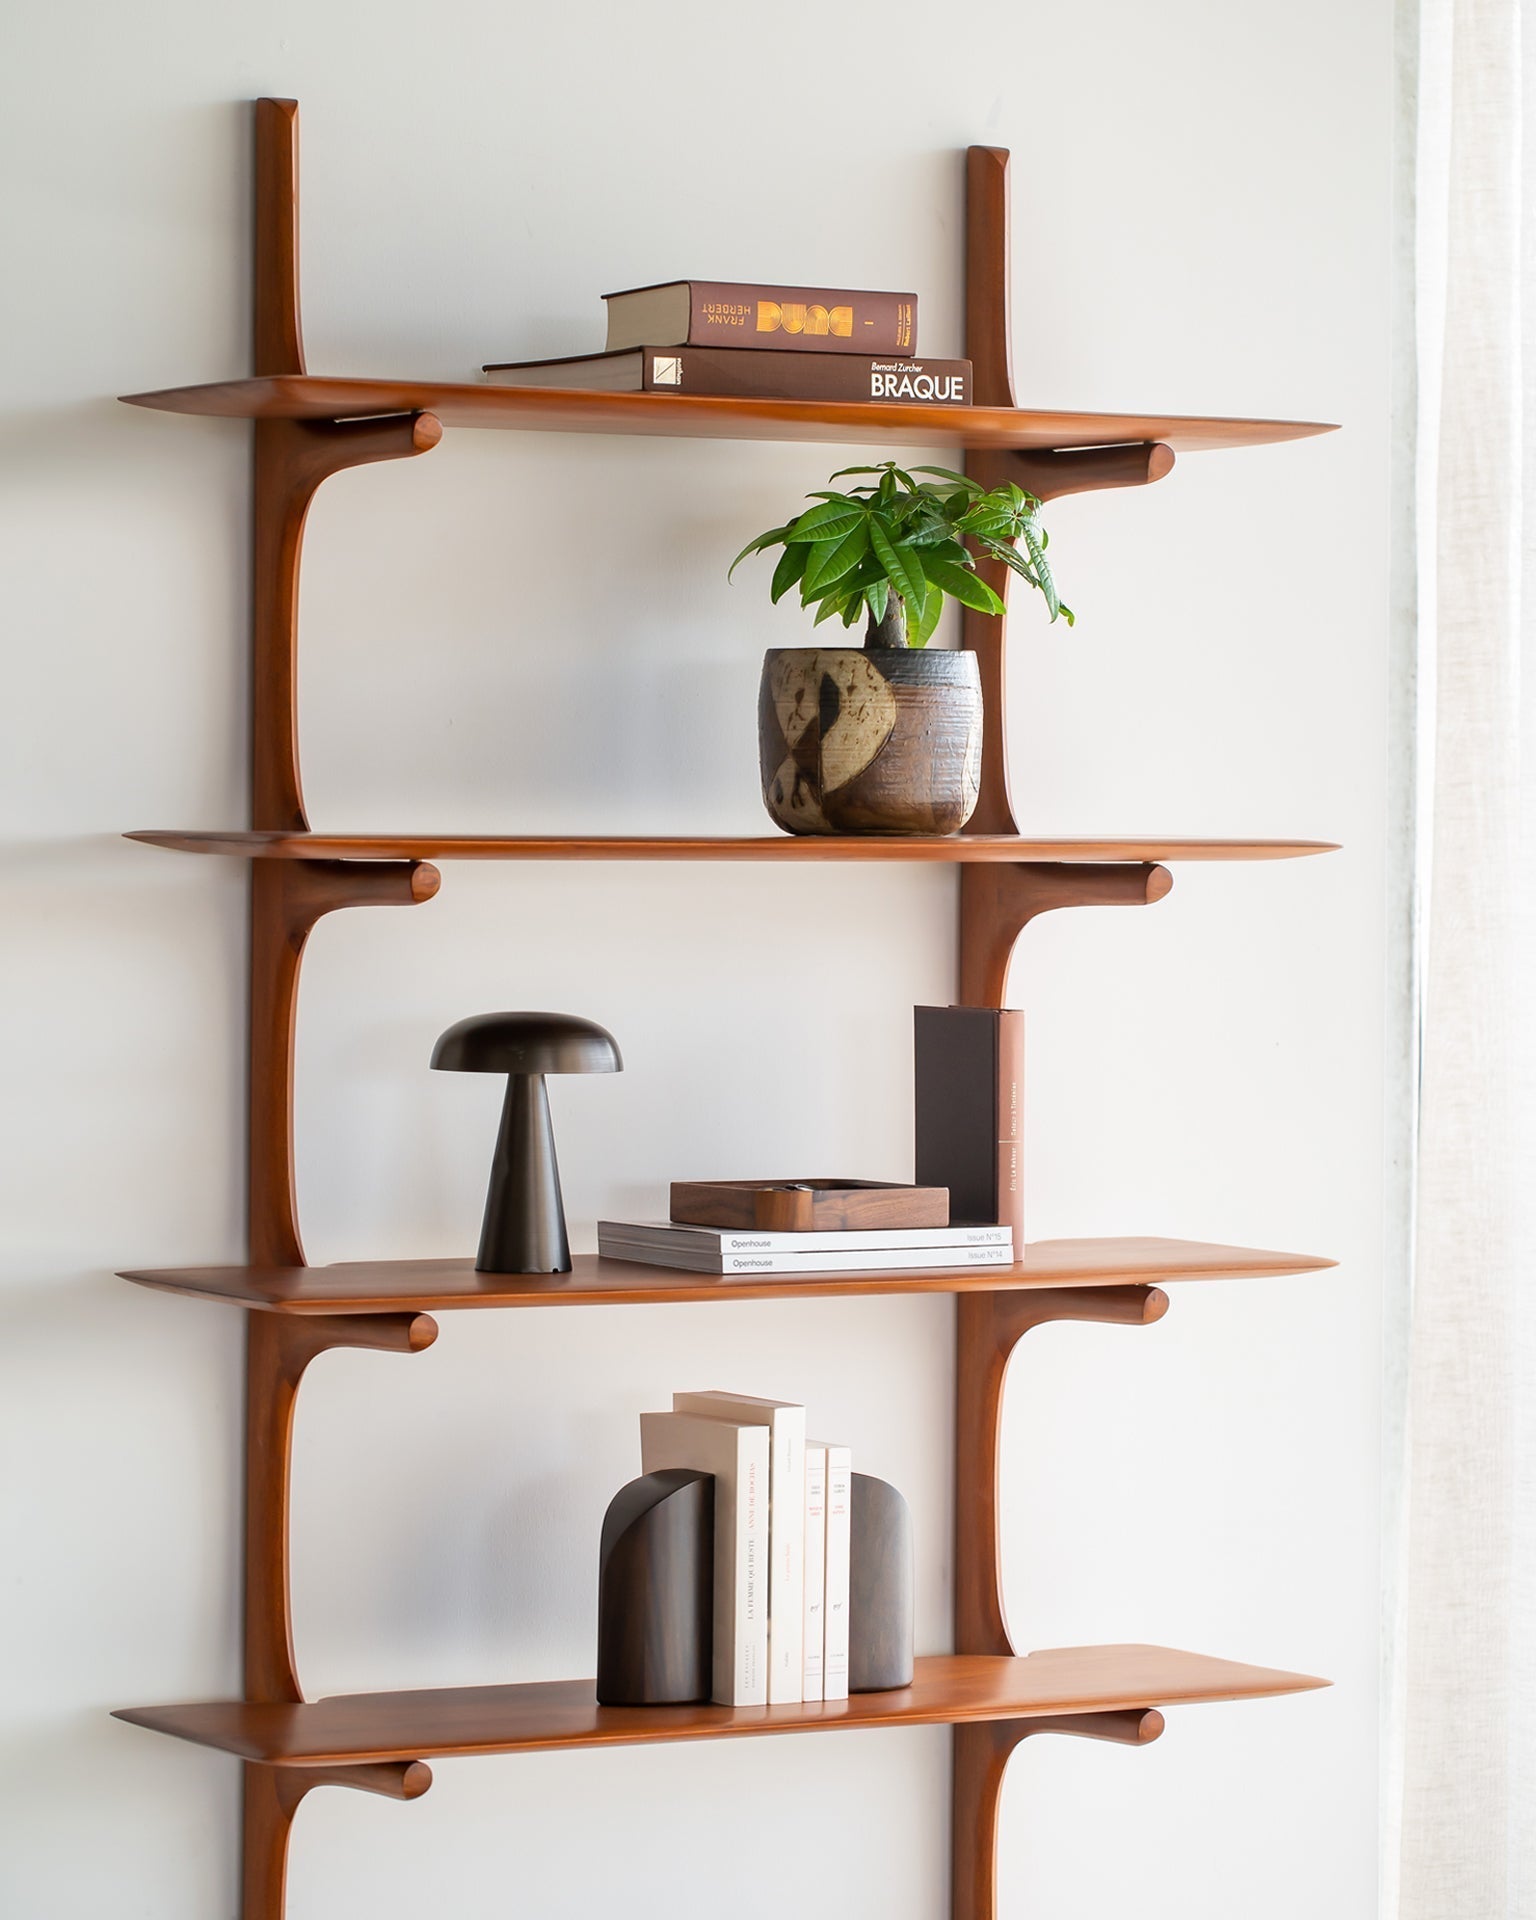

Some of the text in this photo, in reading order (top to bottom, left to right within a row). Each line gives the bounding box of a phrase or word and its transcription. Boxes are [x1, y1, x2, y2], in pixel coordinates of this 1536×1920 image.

[702, 303, 750, 315] HERBERT
[707, 315, 745, 326] FRANK
[871, 361, 923, 373] Bernard Zurcher
[871, 373, 963, 400] BRAQUE
[967, 1233, 985, 1242] Issue
[731, 1239, 772, 1249] Openhouse
[968, 1251, 986, 1260] Issue
[733, 1259, 773, 1268] Openhouse
[748, 1510, 756, 1529] ANNE
[747, 1607, 754, 1620] LA
